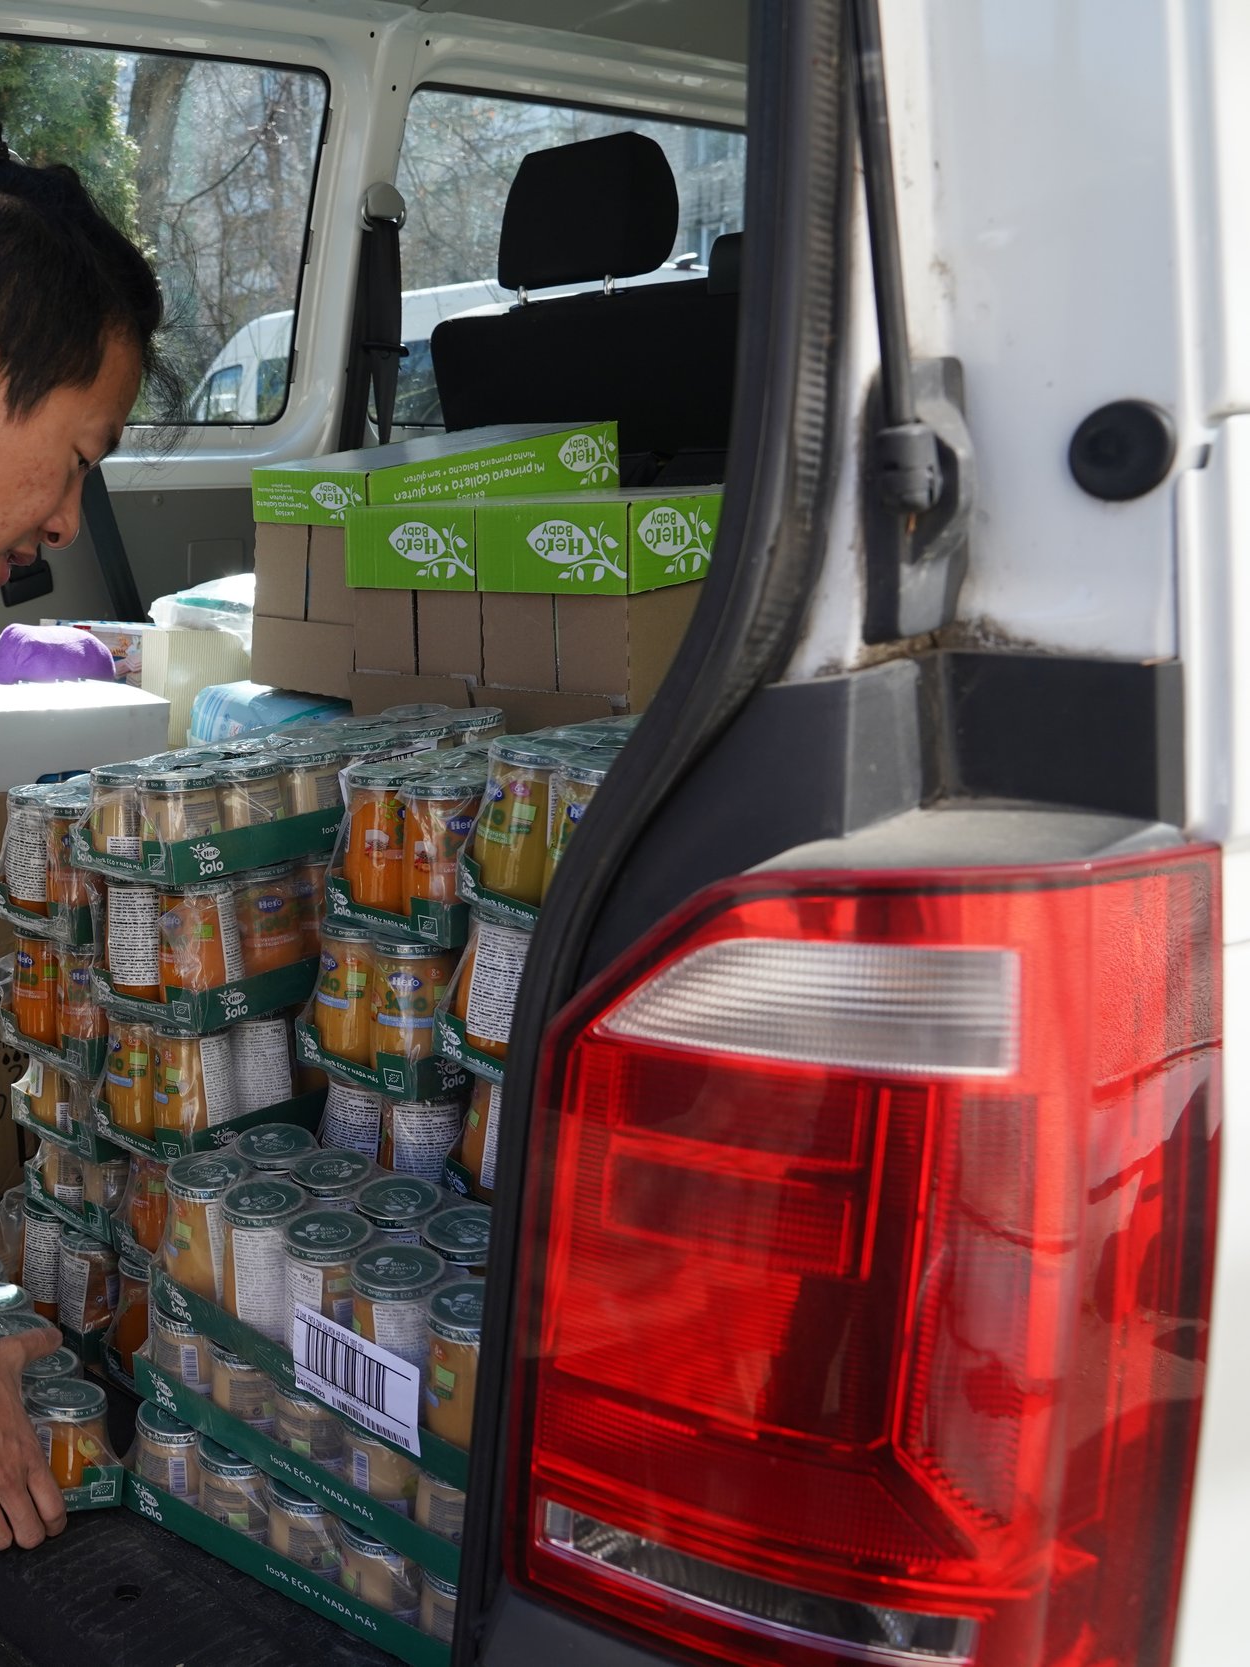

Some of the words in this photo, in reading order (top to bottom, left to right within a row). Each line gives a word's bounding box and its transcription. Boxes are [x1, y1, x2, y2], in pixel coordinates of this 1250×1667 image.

[568, 437, 589, 449] Baby
[479, 455, 513, 467] primeira
[513, 451, 536, 462] Minha
[564, 447, 596, 467] Hero
[448, 461, 479, 475] Bolacha
[494, 464, 532, 483] primera
[533, 461, 545, 474] Mi
[425, 470, 441, 480] Sem
[319, 483, 337, 492] Baby
[428, 483, 442, 495] Sin
[451, 474, 492, 491] Galleta
[315, 492, 343, 505] Hero
[393, 483, 427, 501] gluten
[651, 511, 677, 525] Baby
[402, 524, 428, 538] Baby
[542, 522, 573, 536] Baby
[645, 526, 686, 549] Hero
[395, 537, 438, 555] Hero
[534, 537, 584, 556] Hero
[77, 850, 92, 862] Solo
[203, 849, 219, 859] Hero
[199, 859, 225, 877] Solo
[462, 882, 478, 899] Solo
[258, 898, 283, 909] Hero
[333, 903, 351, 917] Solo
[498, 902, 509, 911] ECO
[516, 909, 534, 920] NADA
[17, 952, 33, 965] Hero
[72, 972, 89, 981] Her
[391, 976, 420, 987] Hero
[230, 993, 245, 1003] Hero
[225, 1004, 249, 1021] Solo
[304, 1047, 320, 1062] Solo
[442, 1041, 462, 1059] Solo
[337, 1062, 346, 1070] ECO
[352, 1069, 366, 1078] NADA
[367, 1075, 378, 1083] MÁS
[441, 1073, 467, 1091] Solo
[300, 1273, 312, 1283] 190g
[170, 1301, 192, 1322] Solo
[281, 1363, 295, 1377] 100
[296, 1376, 326, 1400] 04/10/2023
[156, 1391, 178, 1412] Solo
[269, 1454, 292, 1472] 100%
[293, 1466, 312, 1484] ECO
[313, 1479, 320, 1489] Y
[322, 1485, 351, 1507] NADA
[352, 1505, 374, 1521] MÁS
[139, 1500, 163, 1522] Solo
[265, 1564, 289, 1583] 100%
[291, 1577, 310, 1594] ECO
[312, 1590, 319, 1599] Y
[322, 1595, 352, 1617] NADA
[354, 1615, 378, 1631] MÁS
